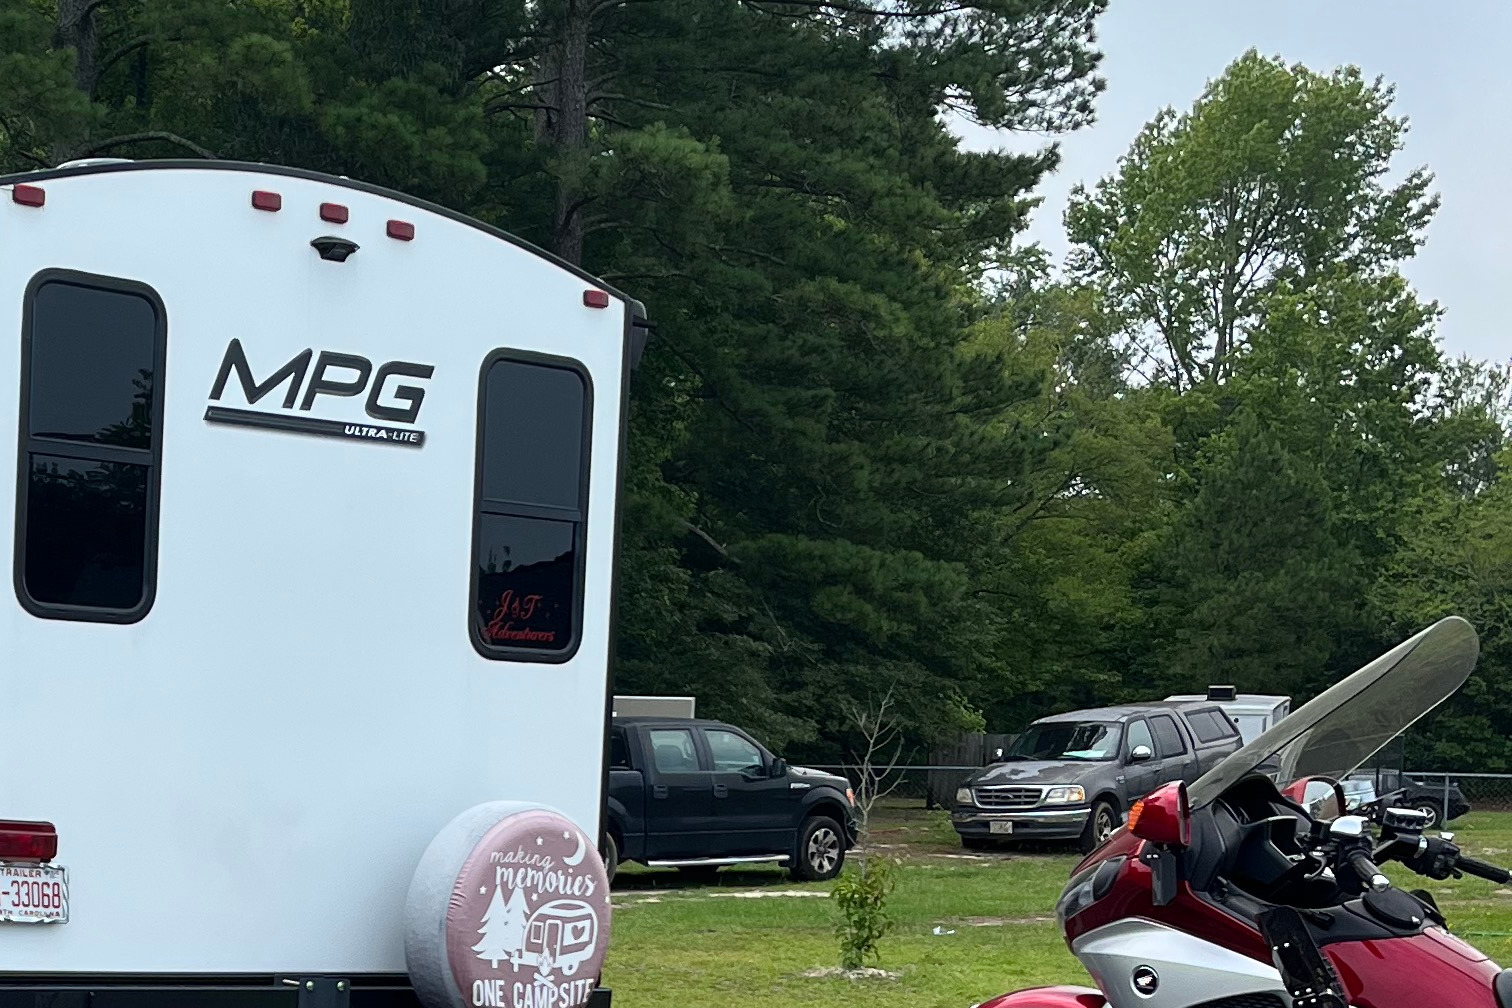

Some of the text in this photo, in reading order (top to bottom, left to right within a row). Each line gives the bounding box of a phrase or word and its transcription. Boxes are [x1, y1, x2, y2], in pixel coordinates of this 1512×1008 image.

[208, 338, 435, 424] MPG
[344, 425, 419, 443] ULTRA-LITE
[0, 867, 42, 878] TRAILER
[489, 845, 556, 875] making
[495, 865, 598, 897] memories
[18, 910, 61, 918] CAROLINA
[472, 979, 505, 1008] ONE
